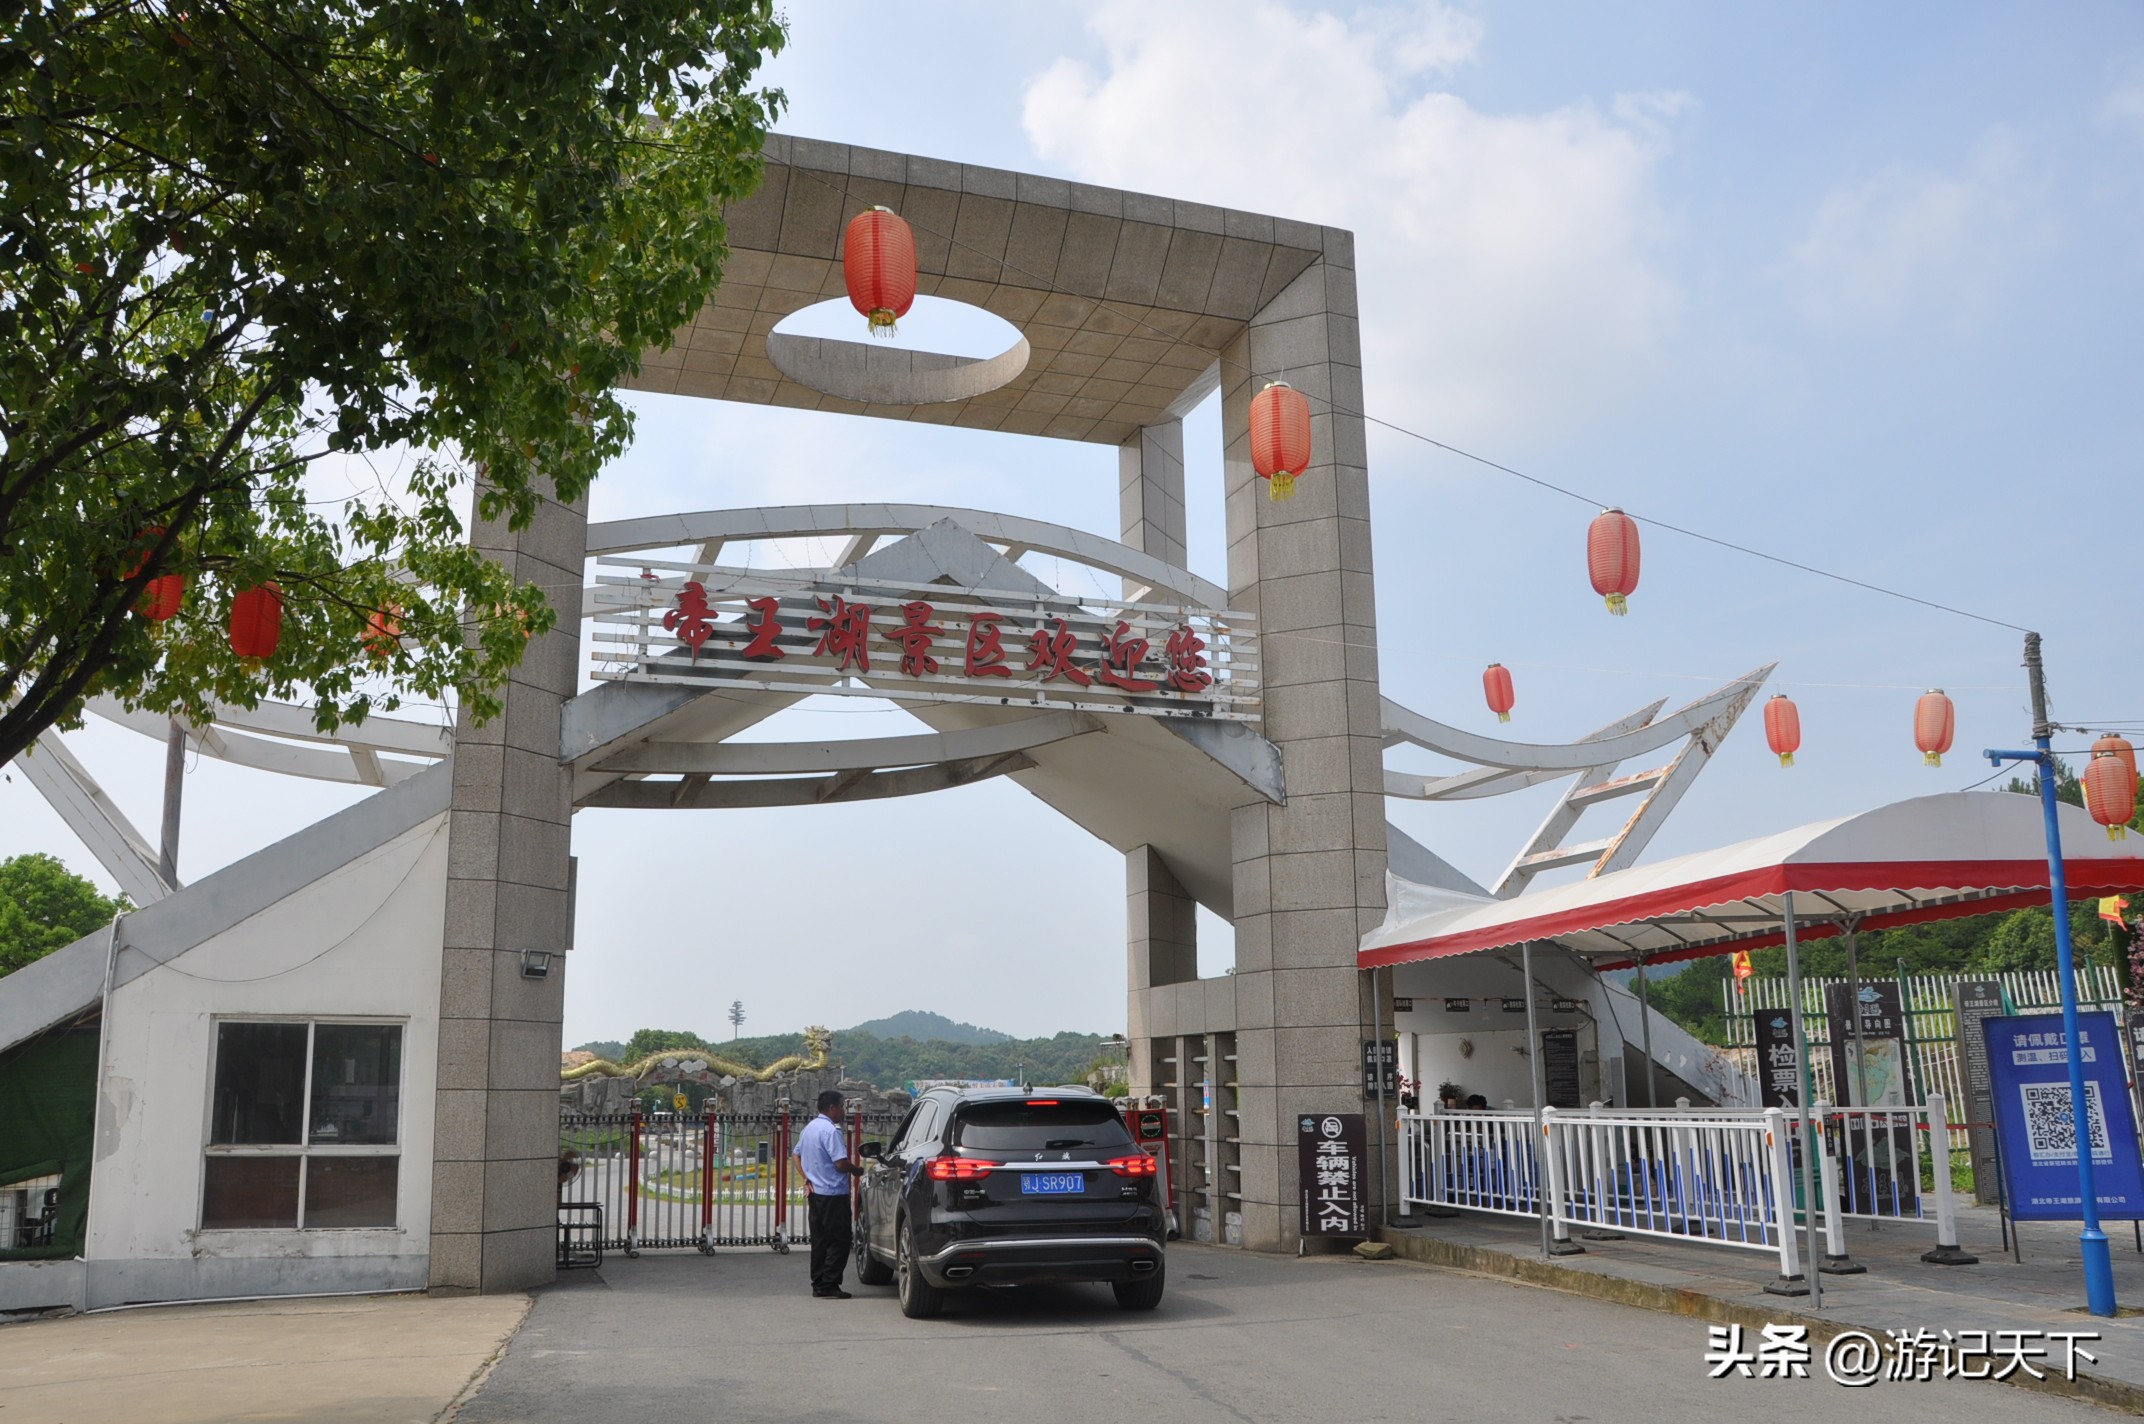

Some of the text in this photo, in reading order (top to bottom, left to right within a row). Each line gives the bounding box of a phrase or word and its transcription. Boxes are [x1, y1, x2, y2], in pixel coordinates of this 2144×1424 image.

[663, 580, 1212, 692] 帝王湖景区欢迎您
[1845, 1018, 1892, 1030] 景导向图
[2016, 1050, 2092, 1062] 测温、扫码入
[1768, 1043, 1799, 1118] 检票入
[1315, 1140, 1351, 1232] 车辆禁止入内
[2031, 1196, 2126, 1205] 湖北帝王湖旅游有限公司
